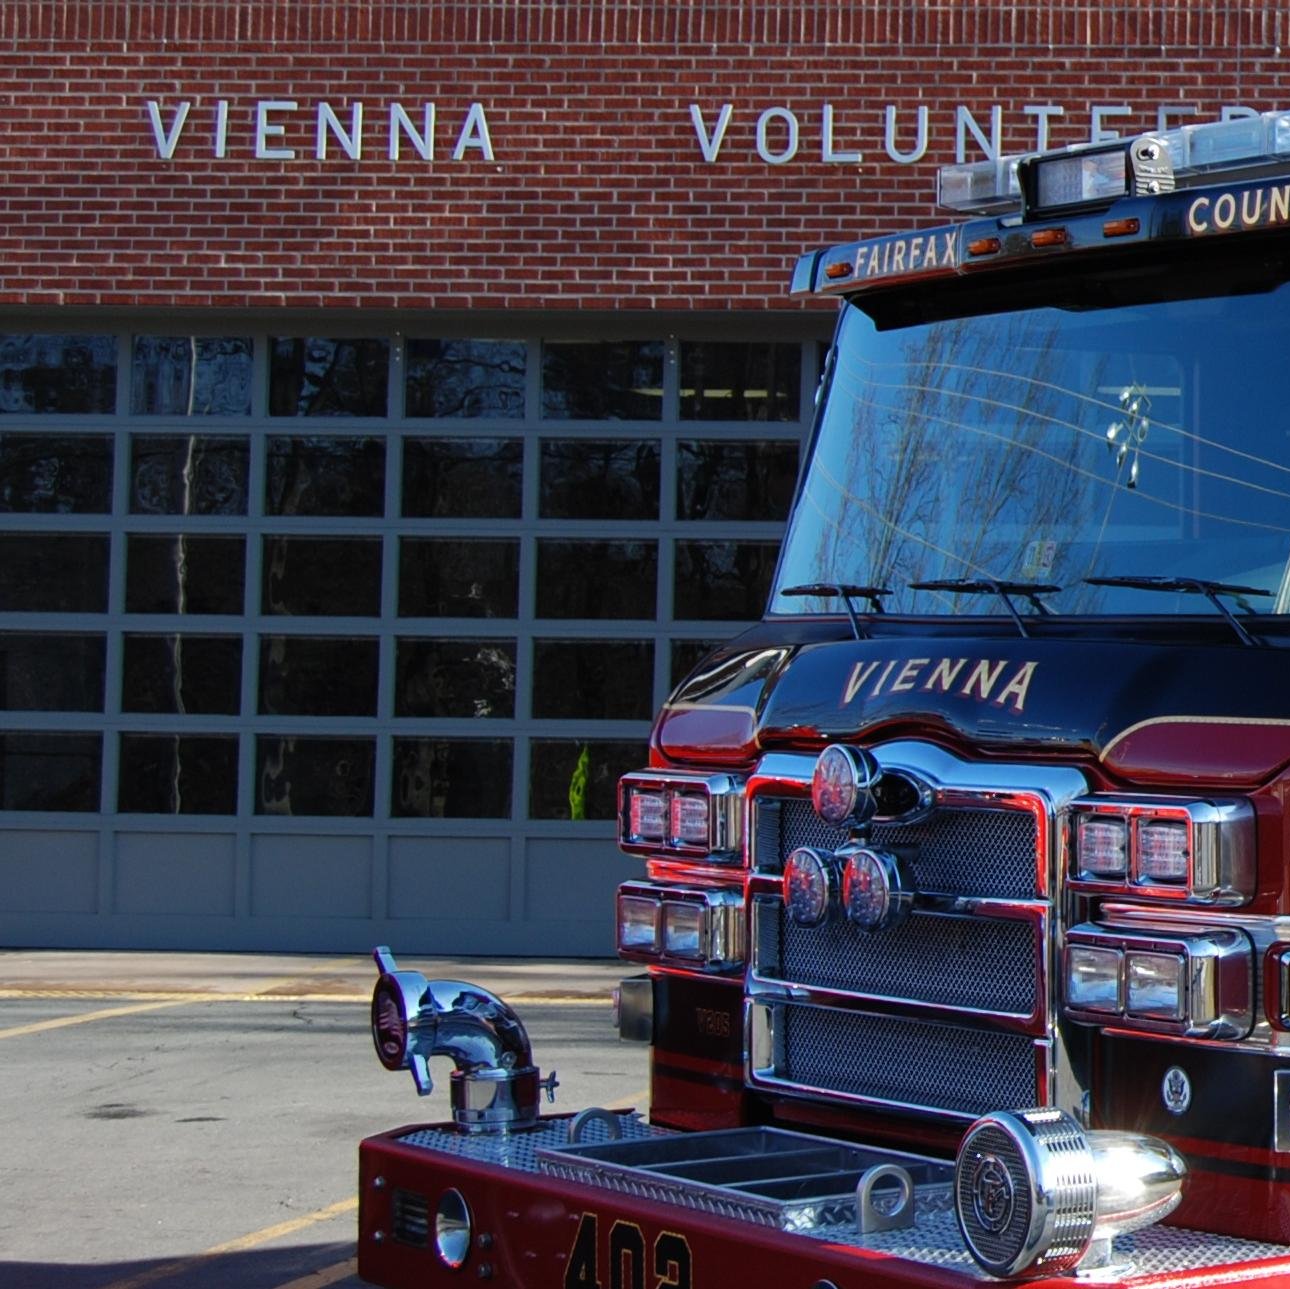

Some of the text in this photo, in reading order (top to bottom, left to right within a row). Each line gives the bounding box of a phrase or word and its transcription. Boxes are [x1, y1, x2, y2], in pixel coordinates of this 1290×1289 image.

[147, 100, 1260, 164] VIENNA VOLUNTE
[854, 231, 957, 277] FAIRFAX
[842, 658, 1040, 712] VIENNA
